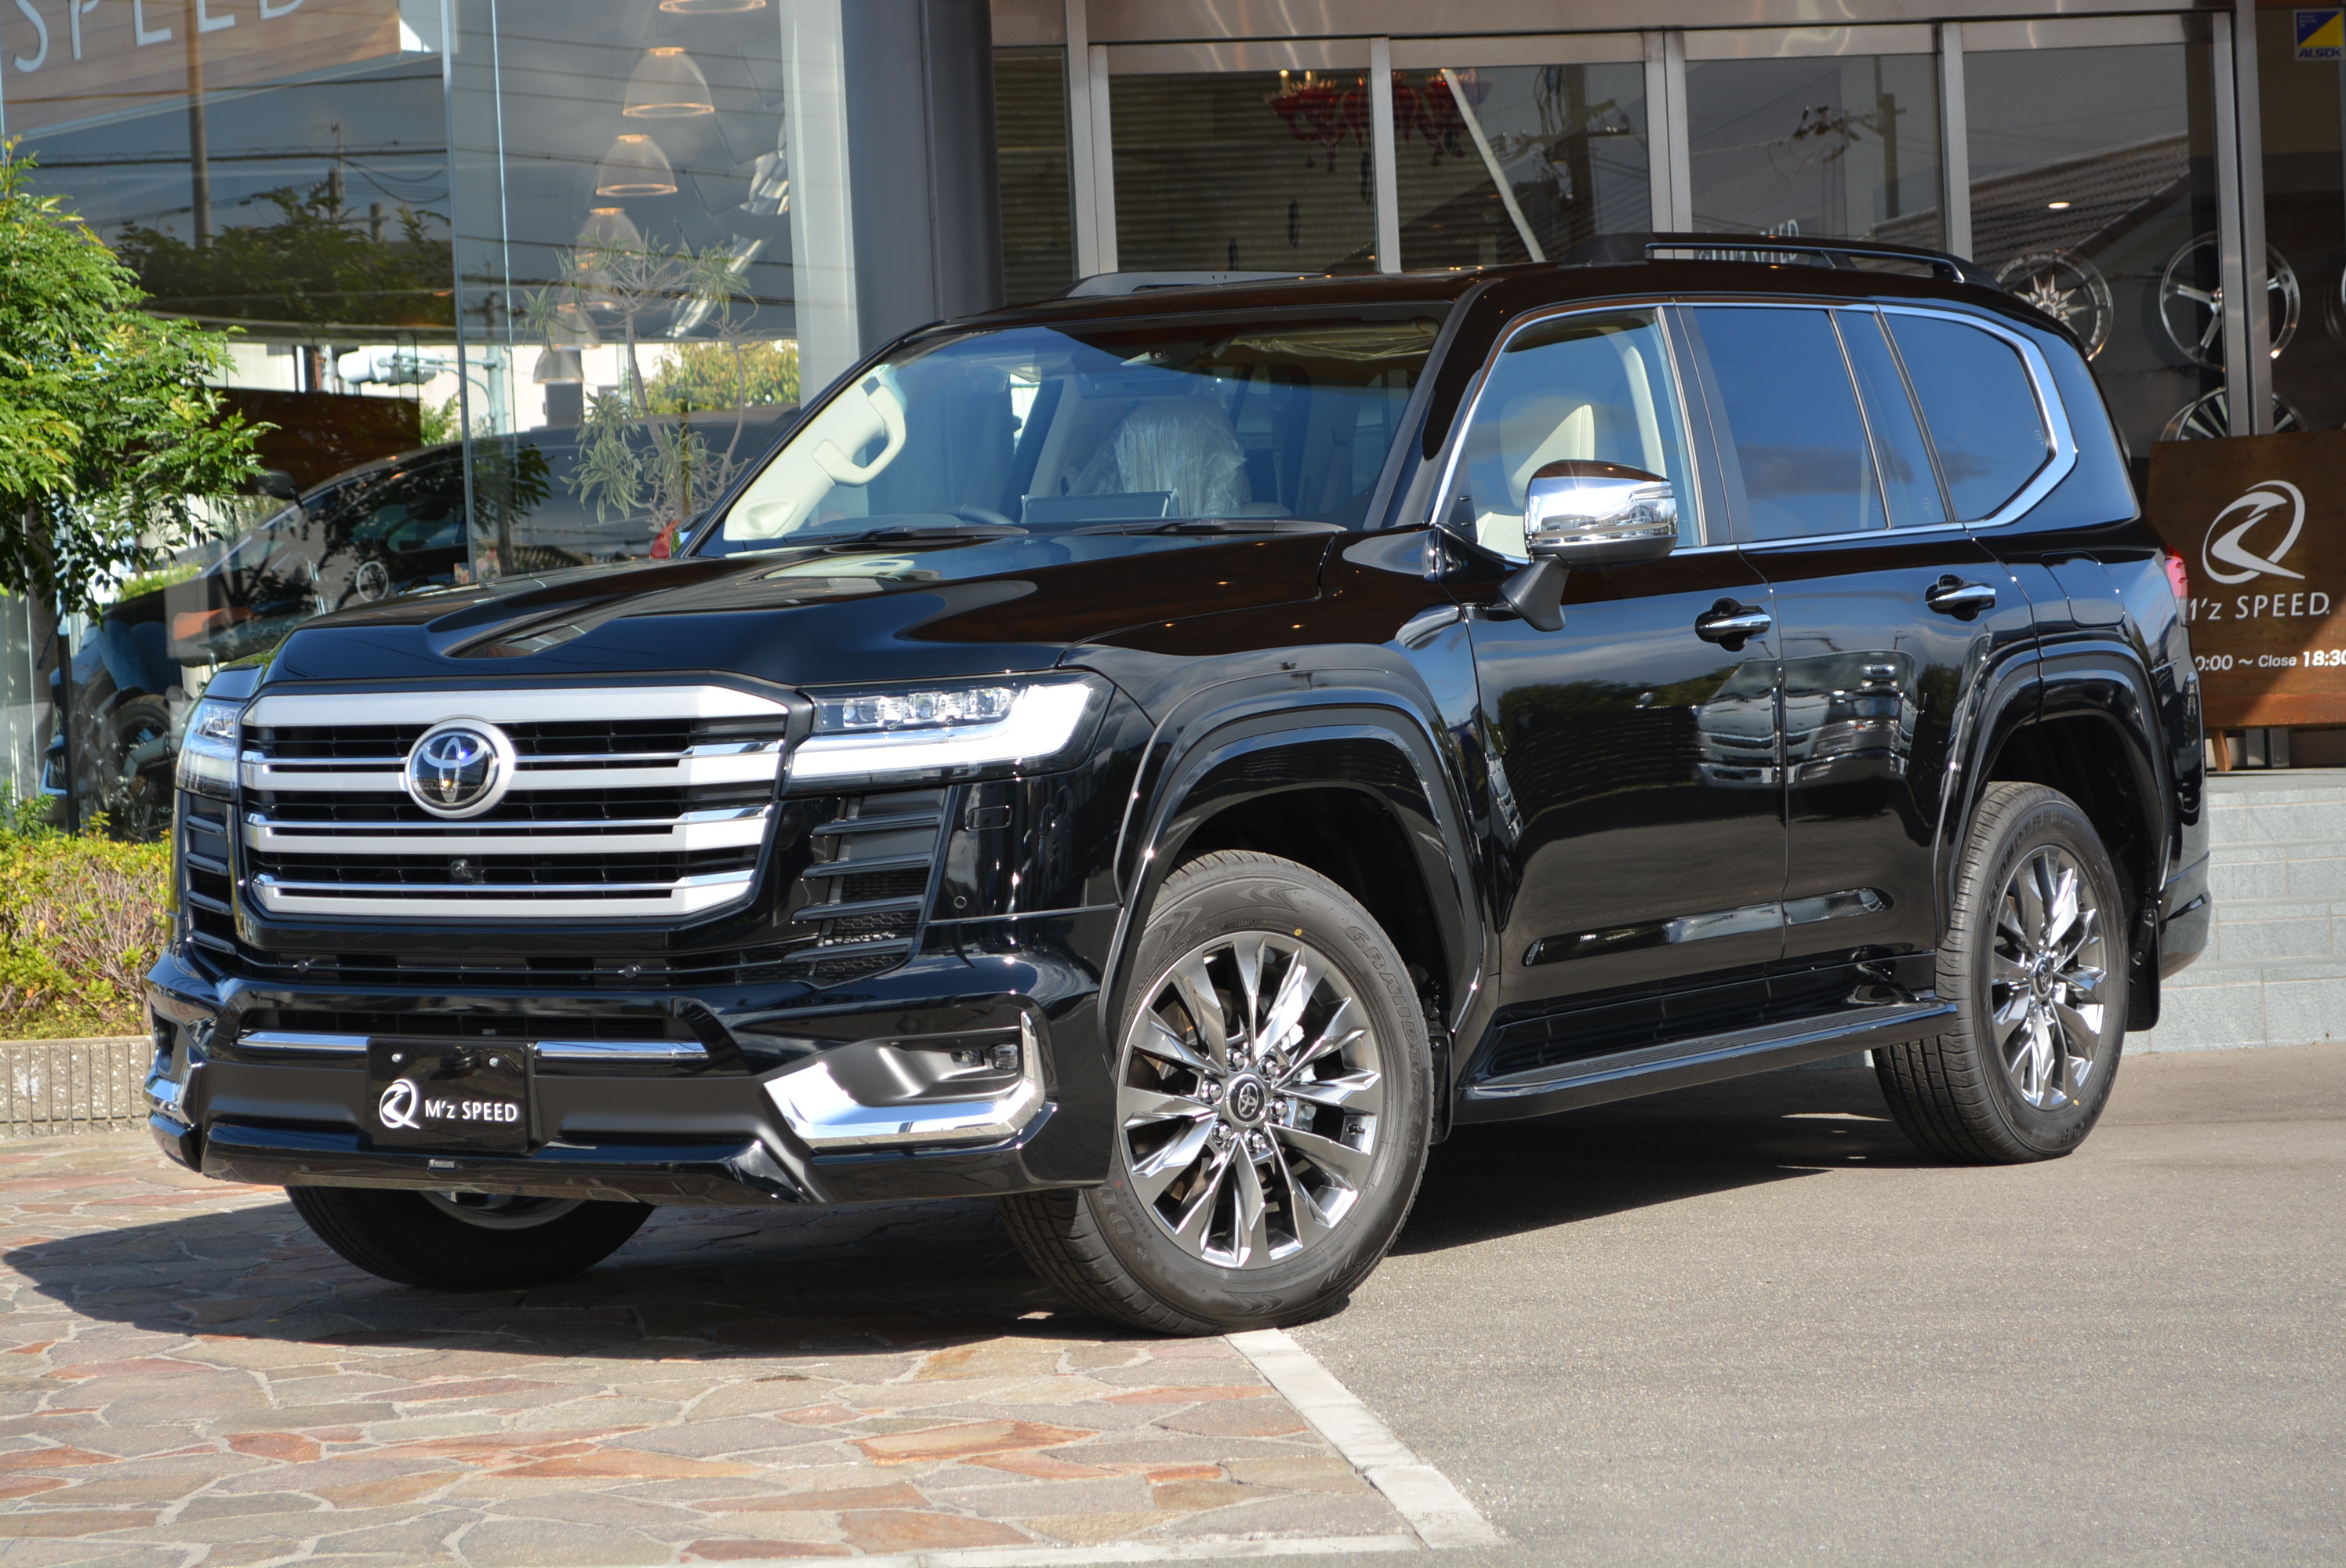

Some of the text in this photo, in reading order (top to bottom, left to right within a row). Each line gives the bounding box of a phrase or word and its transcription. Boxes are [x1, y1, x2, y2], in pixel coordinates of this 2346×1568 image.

[2195, 655, 2233, 671] 0:00
[2258, 654, 2297, 667] Close
[425, 1099, 518, 1122] M'z SPEED
